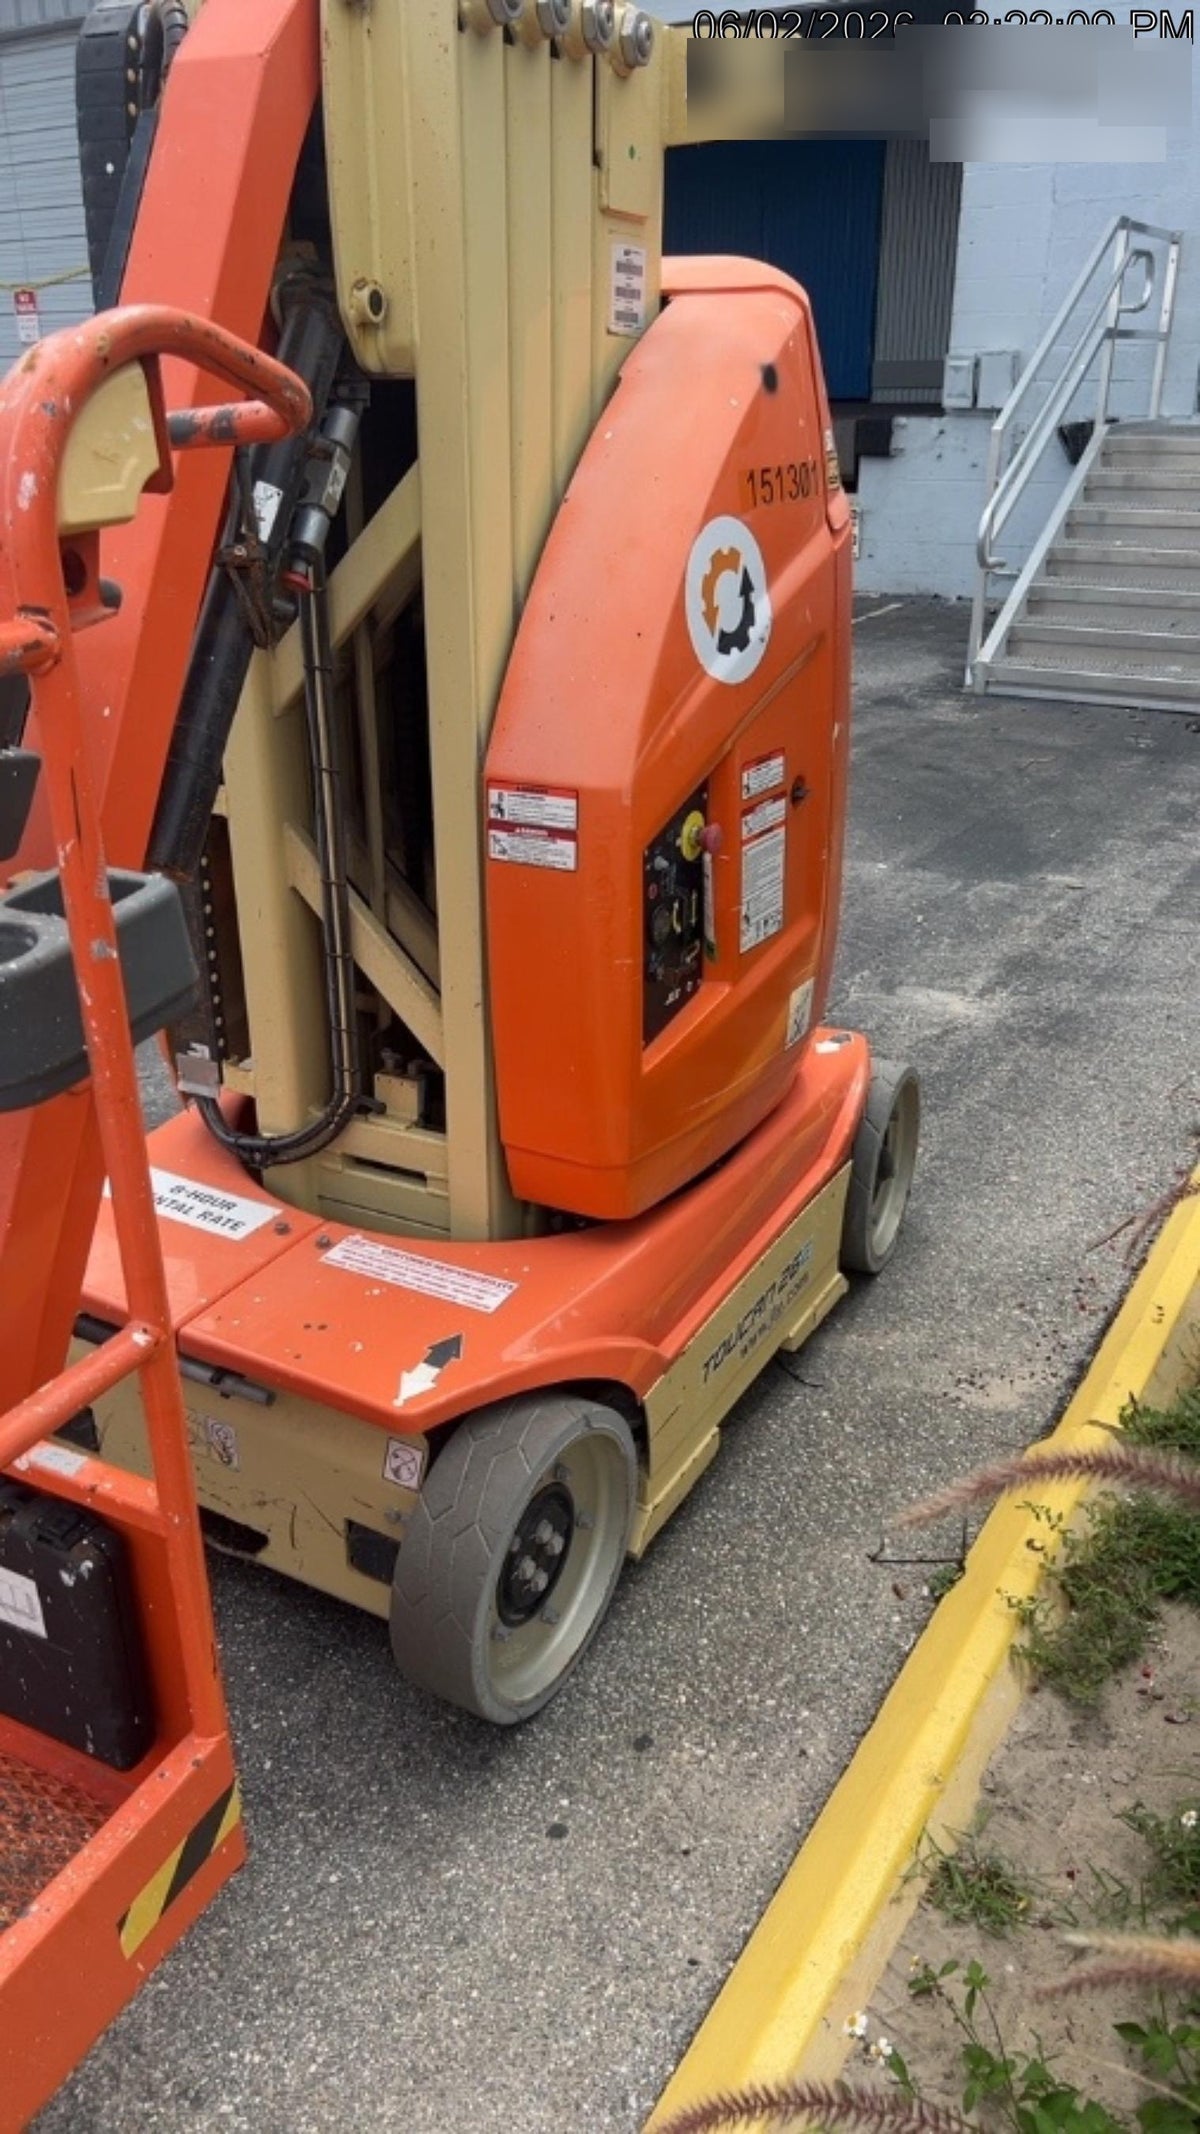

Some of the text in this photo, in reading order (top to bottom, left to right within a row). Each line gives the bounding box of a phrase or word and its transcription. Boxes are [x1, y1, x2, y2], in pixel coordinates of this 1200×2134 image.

[746, 460, 819, 508] 151301
[152, 1192, 246, 1232] NTAL RATE
